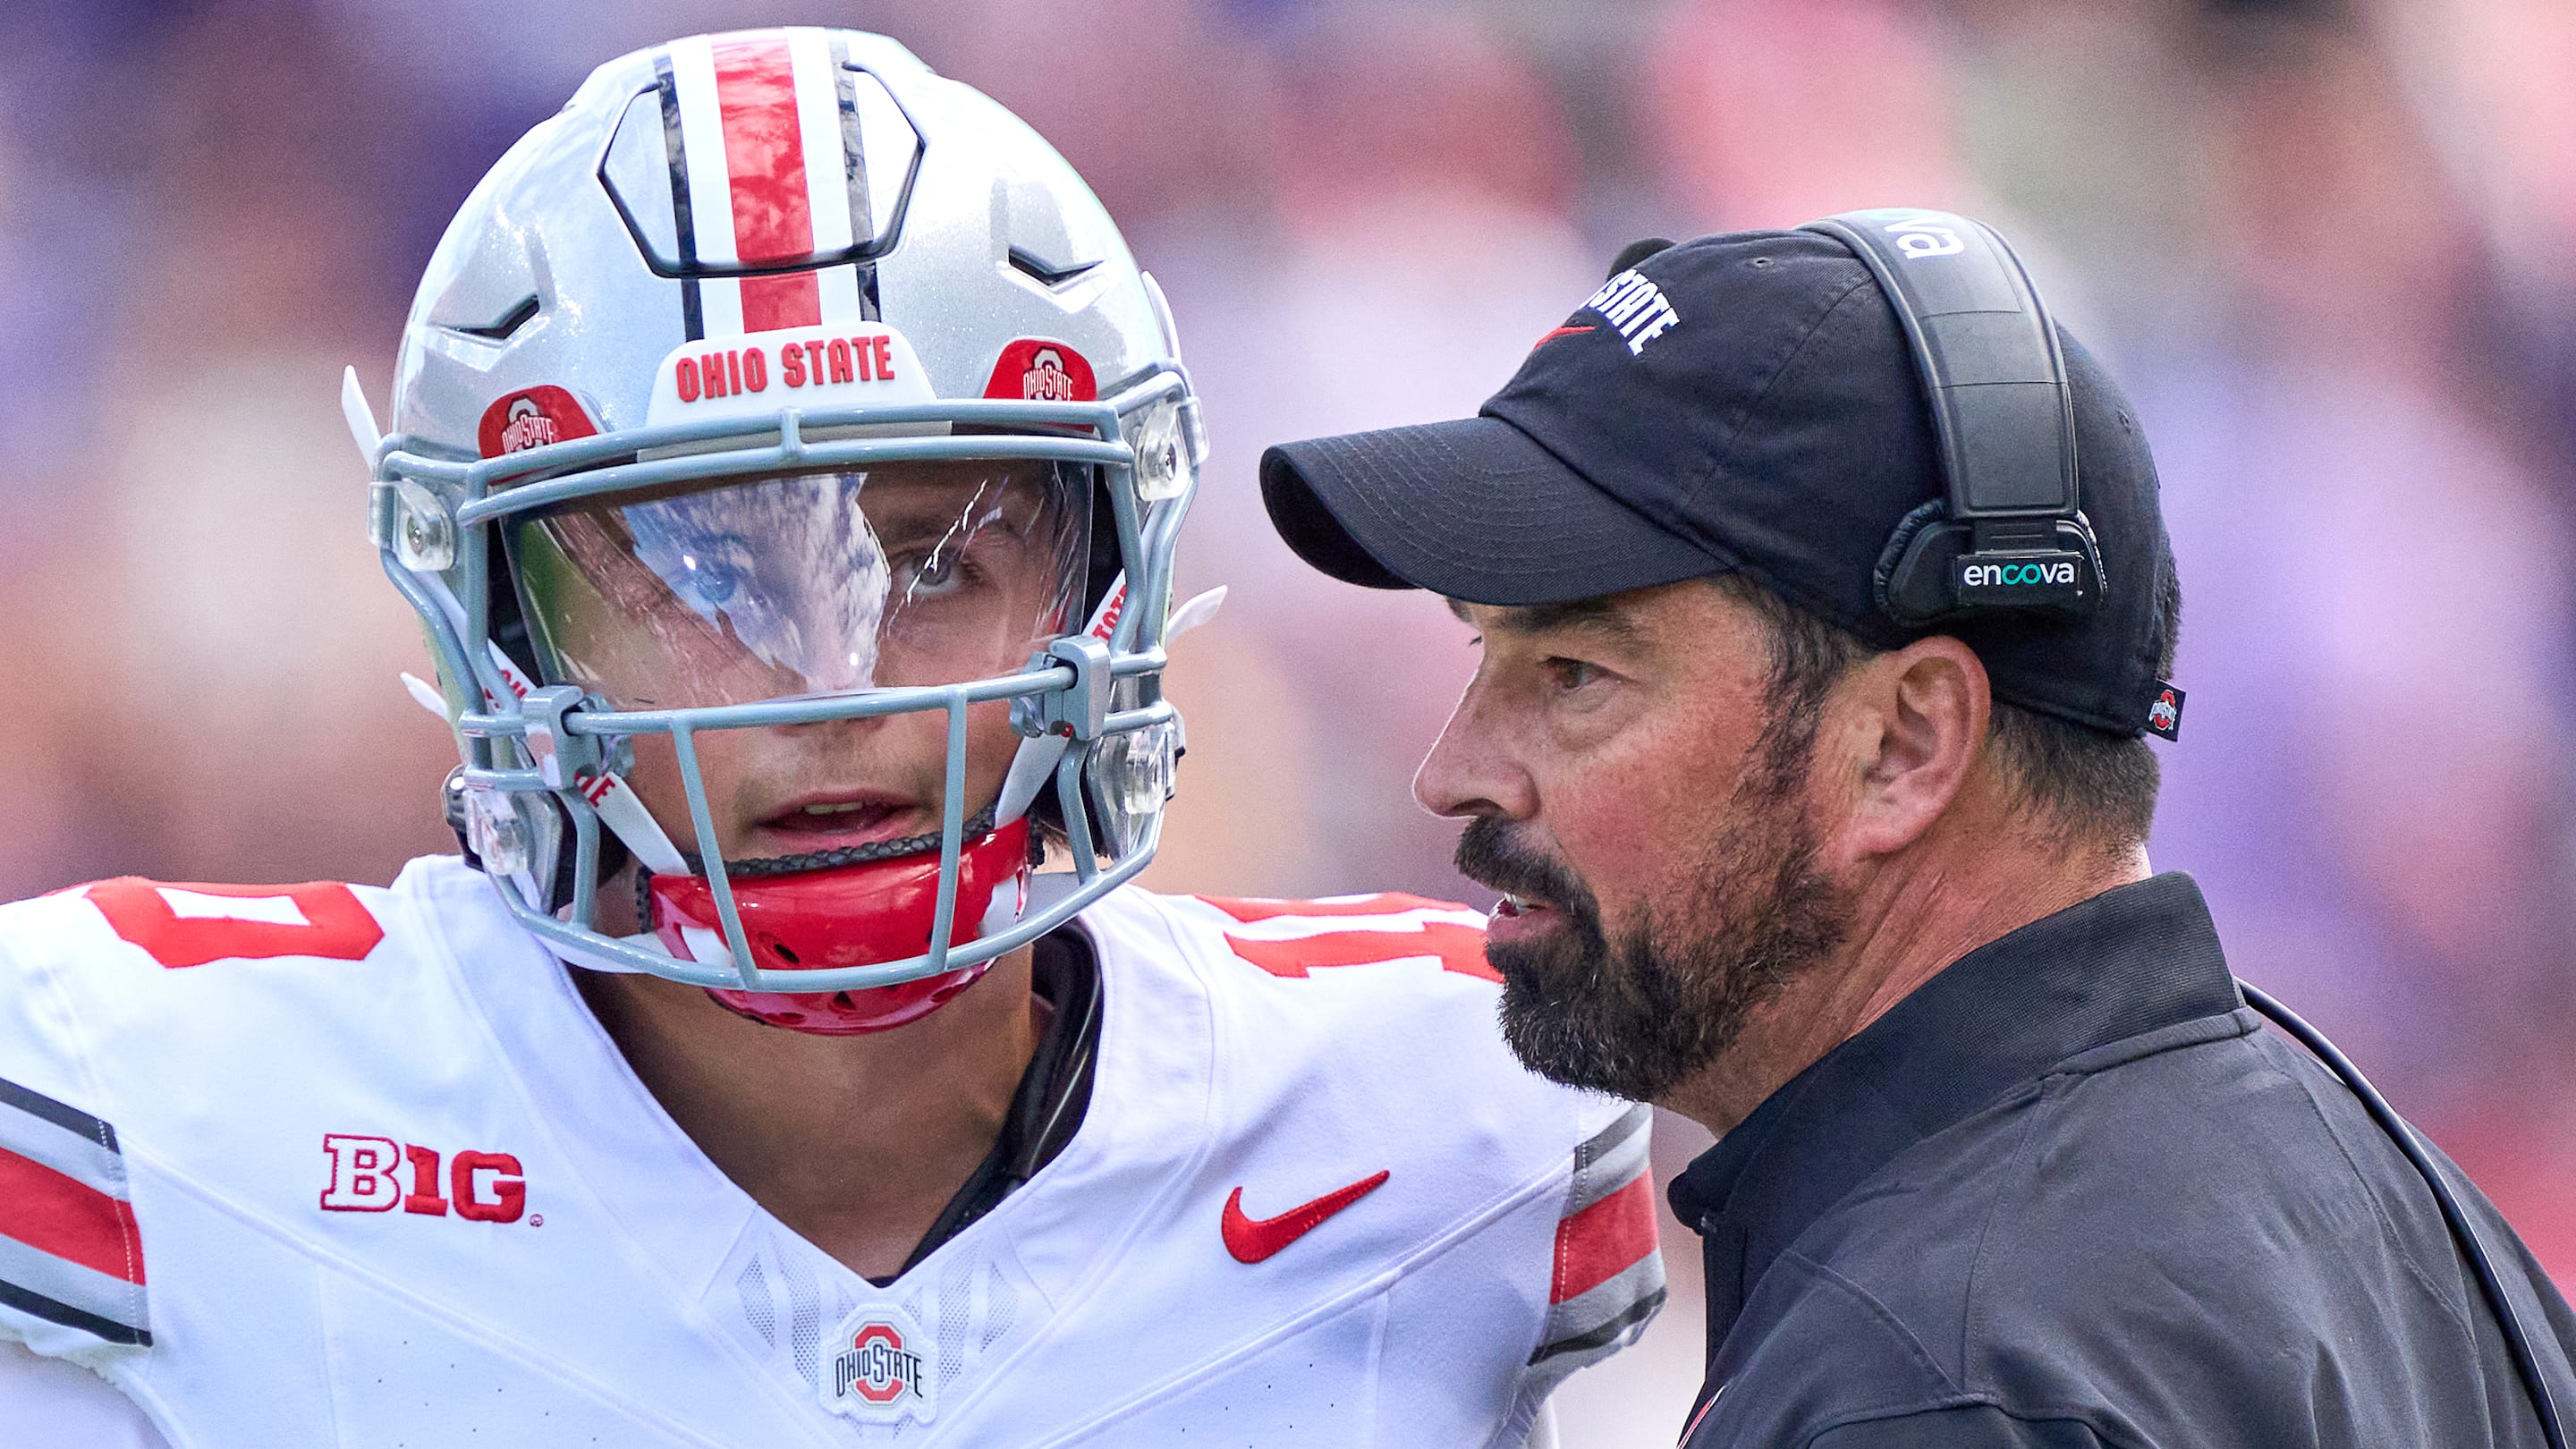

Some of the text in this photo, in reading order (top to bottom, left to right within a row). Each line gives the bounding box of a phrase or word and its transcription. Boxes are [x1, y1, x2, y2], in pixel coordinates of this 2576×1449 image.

[675, 335, 895, 402] OHIO STATE
[1963, 562, 2075, 587] encova
